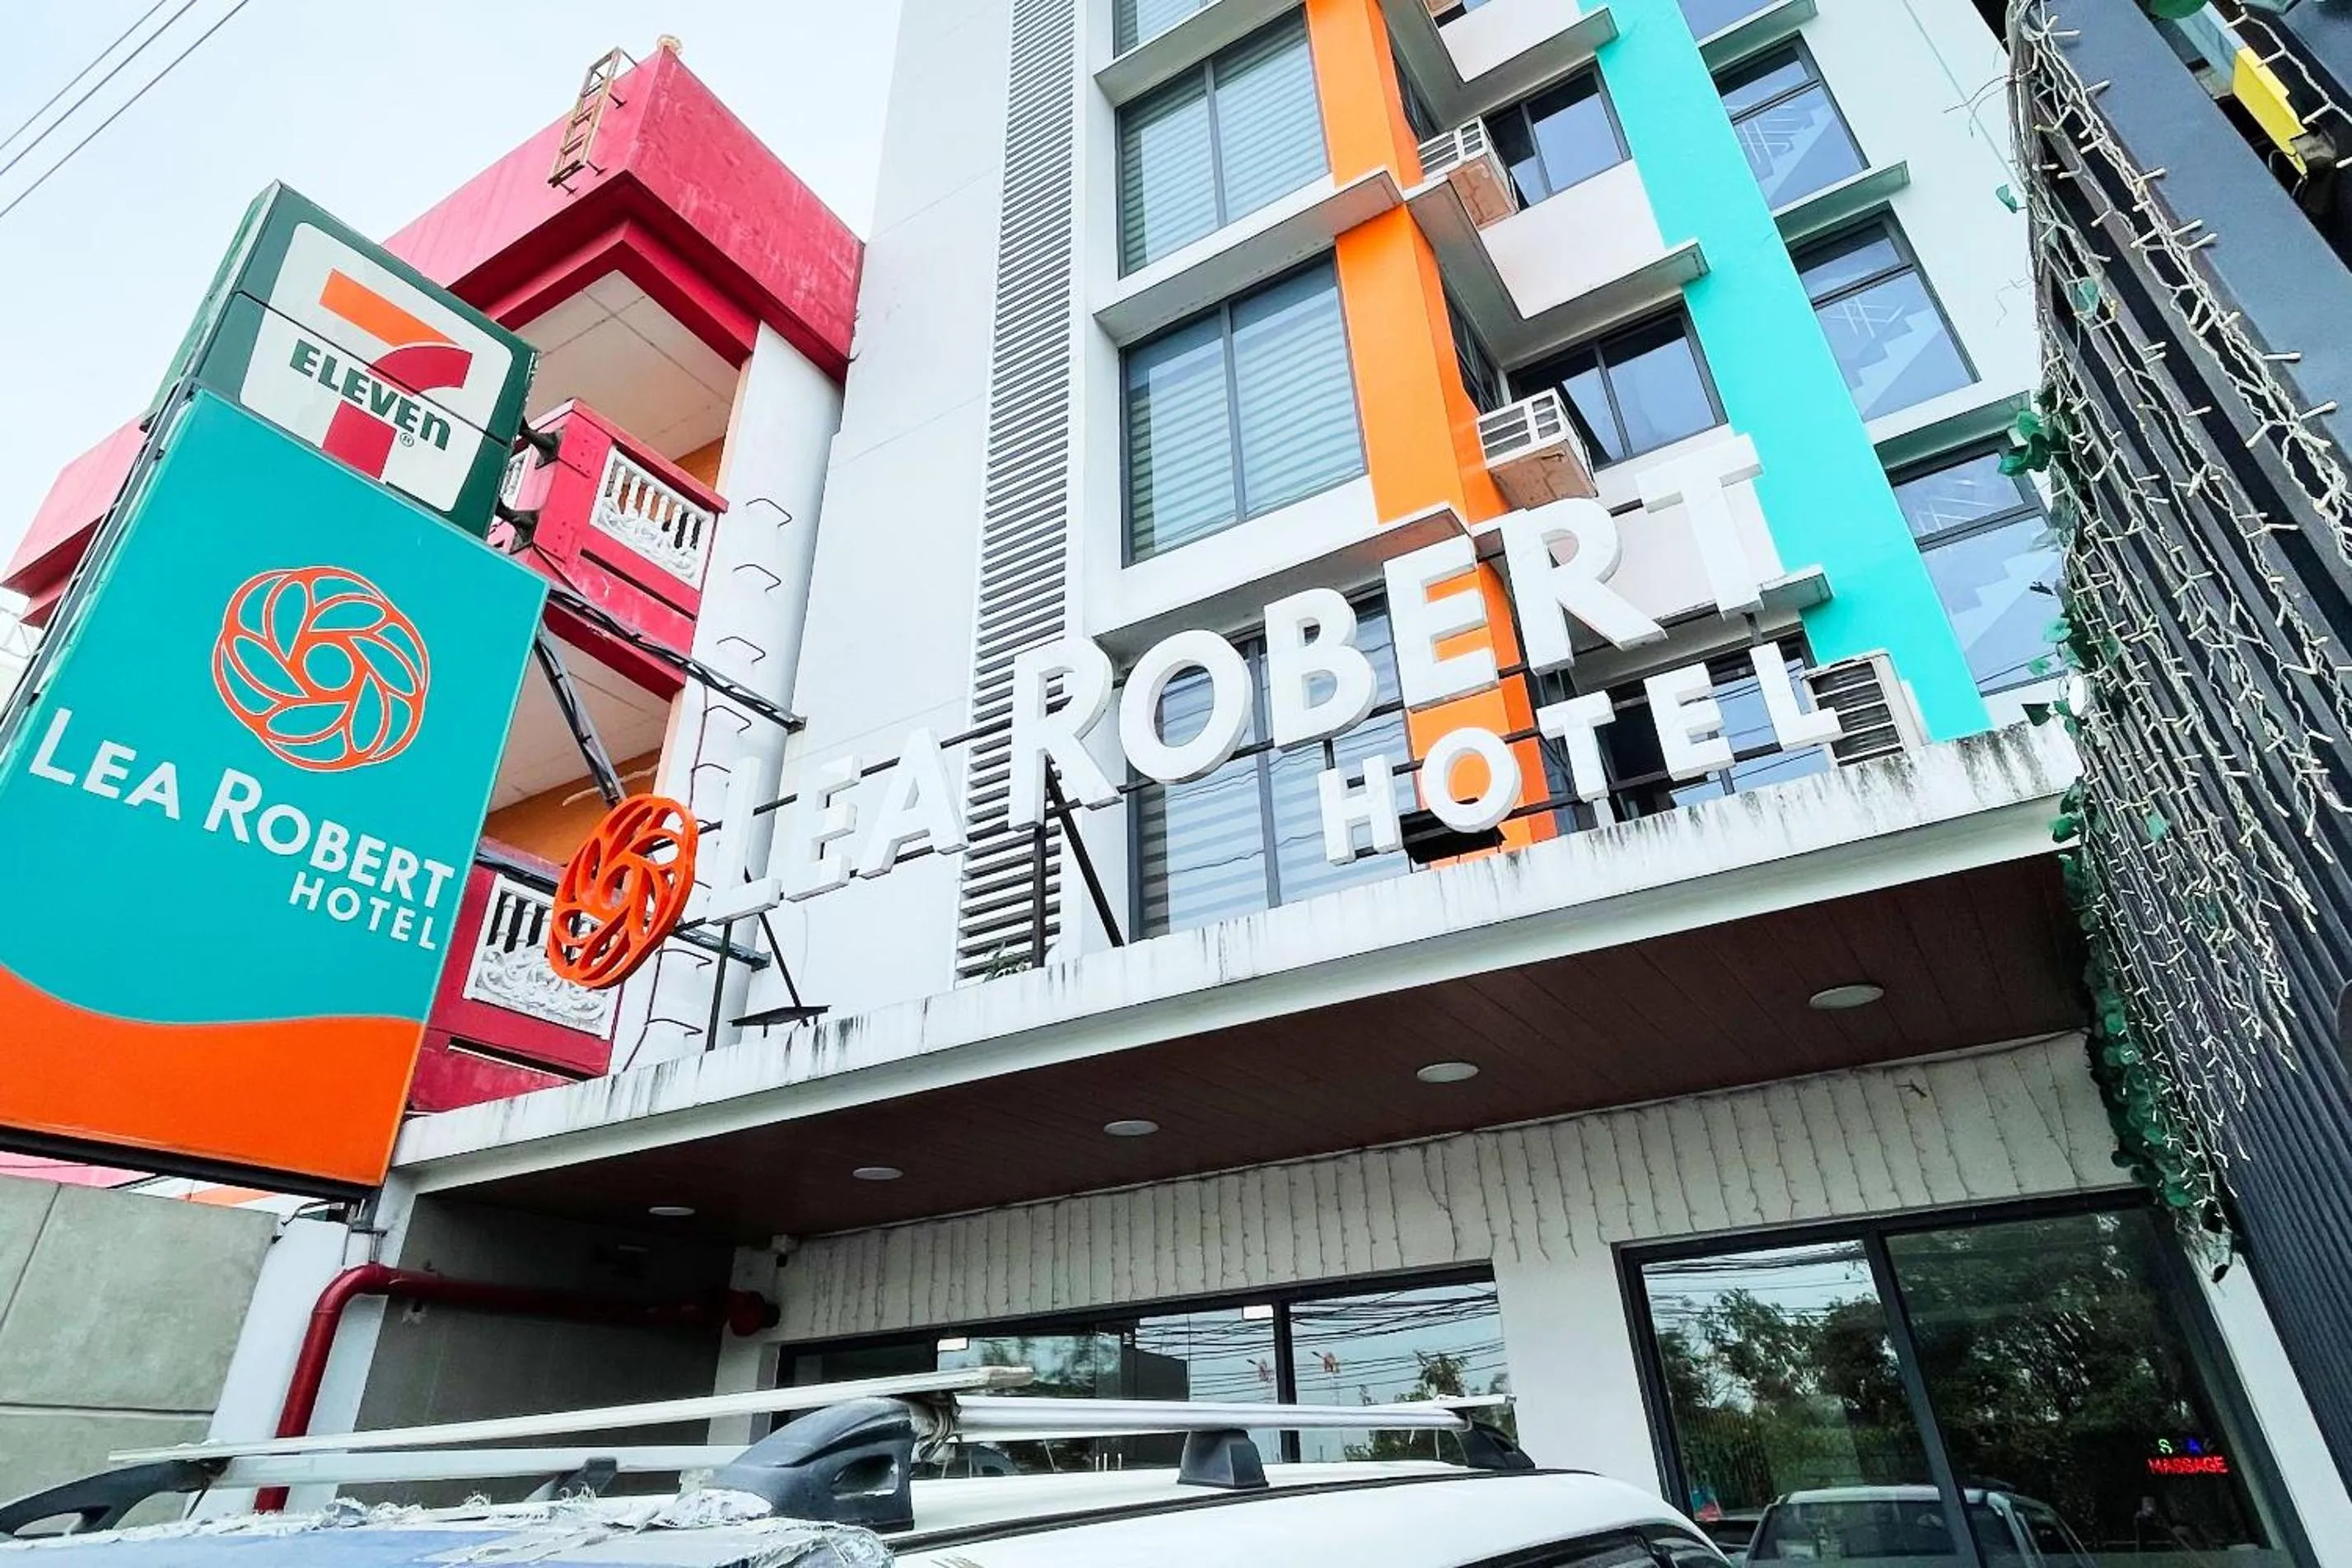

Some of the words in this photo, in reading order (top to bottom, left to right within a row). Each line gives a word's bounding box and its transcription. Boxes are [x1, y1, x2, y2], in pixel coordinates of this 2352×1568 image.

[319, 268, 474, 480] 7
[706, 725, 969, 926] LEA
[1008, 432, 1764, 832] ROBERT
[1318, 642, 1844, 866] HOTEL
[28, 707, 181, 821] LEA
[203, 768, 455, 909] ROBERT
[288, 870, 437, 951] HOTEL
[2147, 1455, 2228, 1475] MASSAGE
